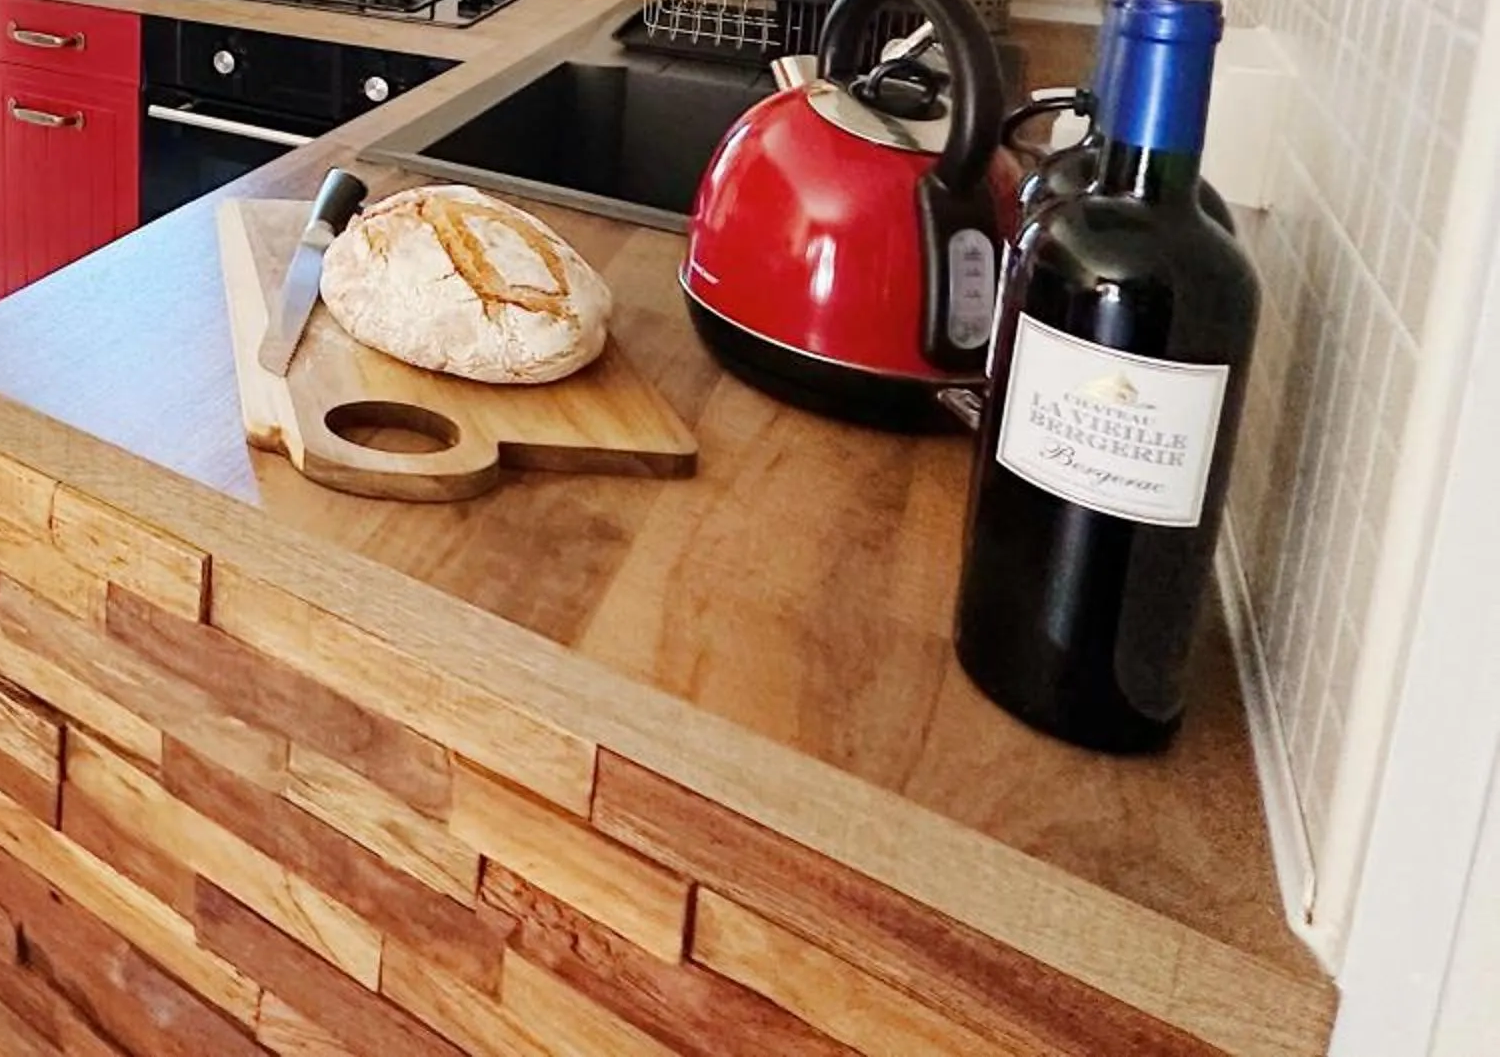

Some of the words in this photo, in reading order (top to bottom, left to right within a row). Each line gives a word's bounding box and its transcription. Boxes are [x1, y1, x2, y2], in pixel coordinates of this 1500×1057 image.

[1029, 409, 1187, 468] BERGERIE
[1031, 392, 1062, 418] LA
[1071, 409, 1188, 450] VIEILLE
[1039, 442, 1166, 493] Bergerac
